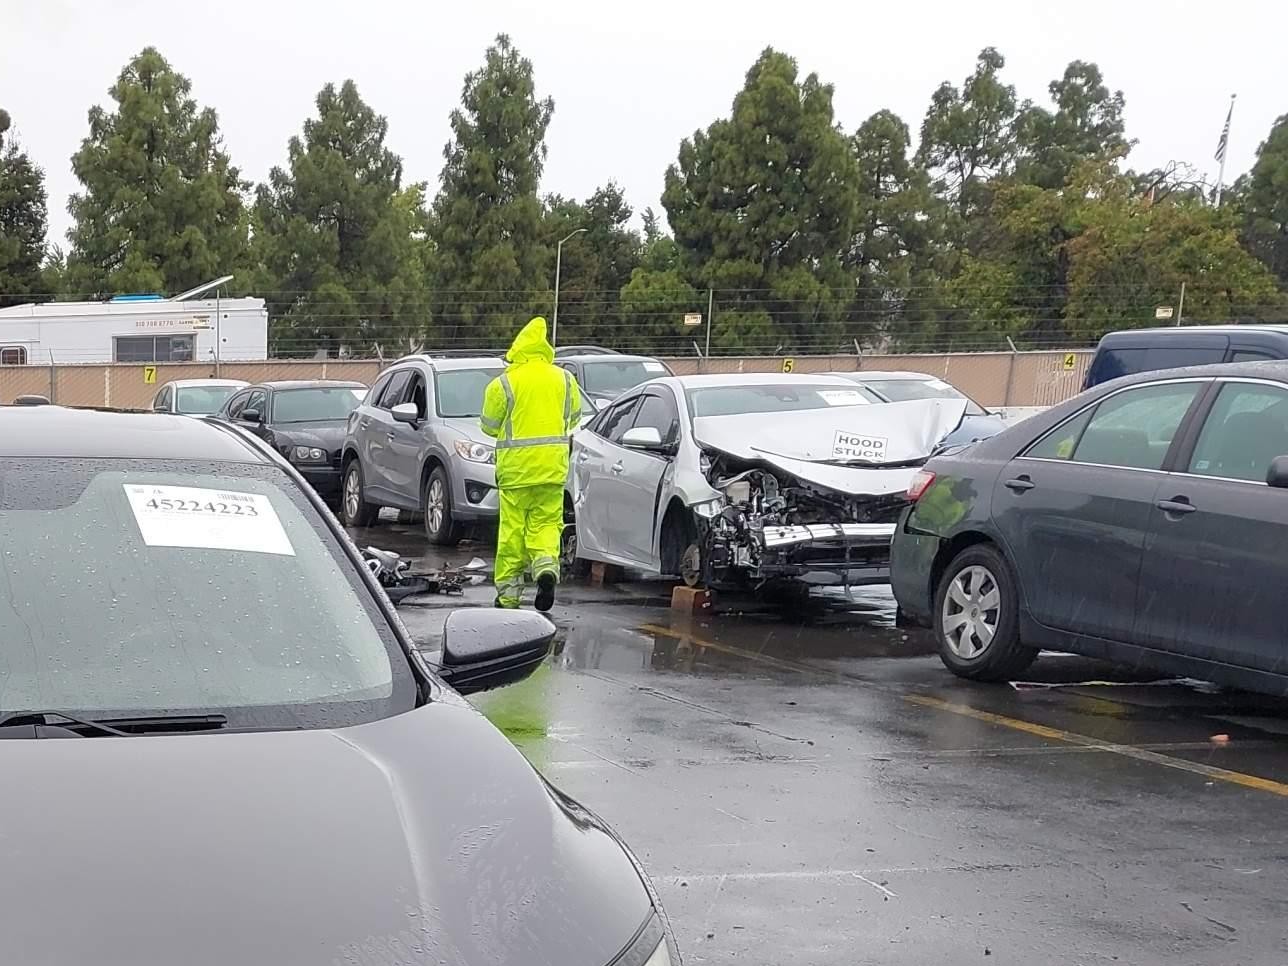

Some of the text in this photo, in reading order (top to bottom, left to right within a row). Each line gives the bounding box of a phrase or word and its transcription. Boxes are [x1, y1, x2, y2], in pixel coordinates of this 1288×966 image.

[784, 360, 792, 373] 5
[1065, 355, 1073, 367] 4
[146, 368, 154, 381] 7
[838, 435, 883, 449] HOOD
[834, 447, 884, 458] STUCK
[145, 498, 259, 517] 45224223
